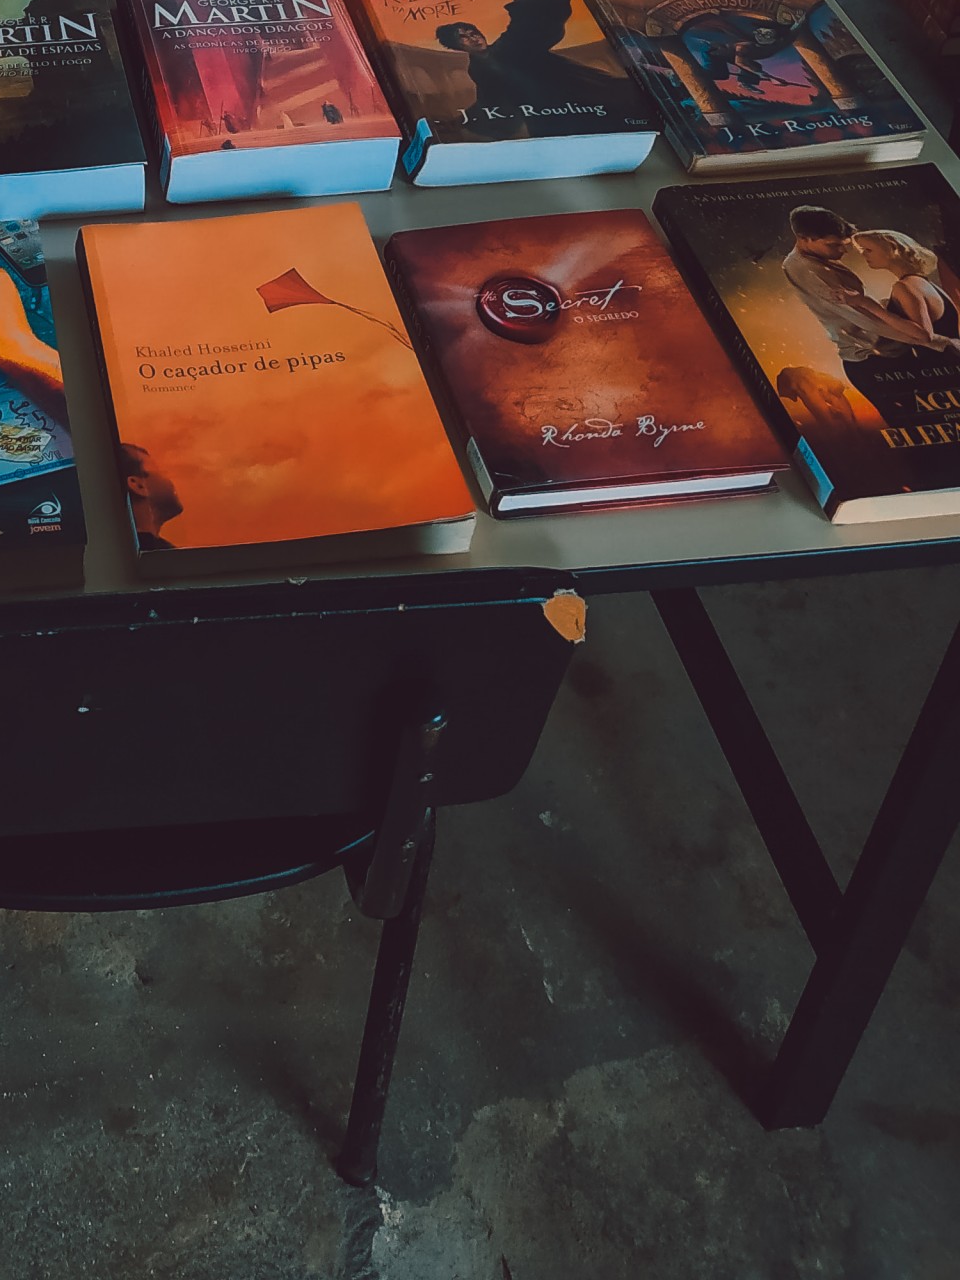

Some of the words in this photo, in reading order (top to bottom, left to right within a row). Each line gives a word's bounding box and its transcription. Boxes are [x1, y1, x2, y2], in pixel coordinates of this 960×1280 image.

[29, 13, 52, 25] R.R.
[403, 0, 463, 23] MORTE
[162, 32, 171, 40] A
[175, 28, 227, 38] DANÇA
[231, 26, 261, 35] DOS
[19, 47, 38, 56] DE
[42, 43, 102, 54] ESPADAS
[456, 108, 477, 125] J.
[482, 106, 514, 120] K.
[518, 102, 607, 118] Rowling
[721, 126, 743, 142] J.
[745, 123, 779, 138] K.
[784, 114, 873, 133] Rowling
[755, 190, 789, 199] MAIOR
[876, 179, 908, 188] TERRA
[502, 279, 642, 319] Secret
[574, 316, 584, 325] O
[586, 311, 639, 323] SEGREDO
[135, 344, 192, 358] Khaled
[197, 339, 272, 355] Hosseini
[138, 363, 156, 379] O
[163, 360, 247, 381] caçador
[254, 355, 281, 371] de
[286, 350, 347, 373] pipas
[874, 371, 916, 382] SARA
[142, 384, 196, 393] Romance
[541, 418, 624, 448] Rhonda
[635, 414, 707, 447] Byrne
